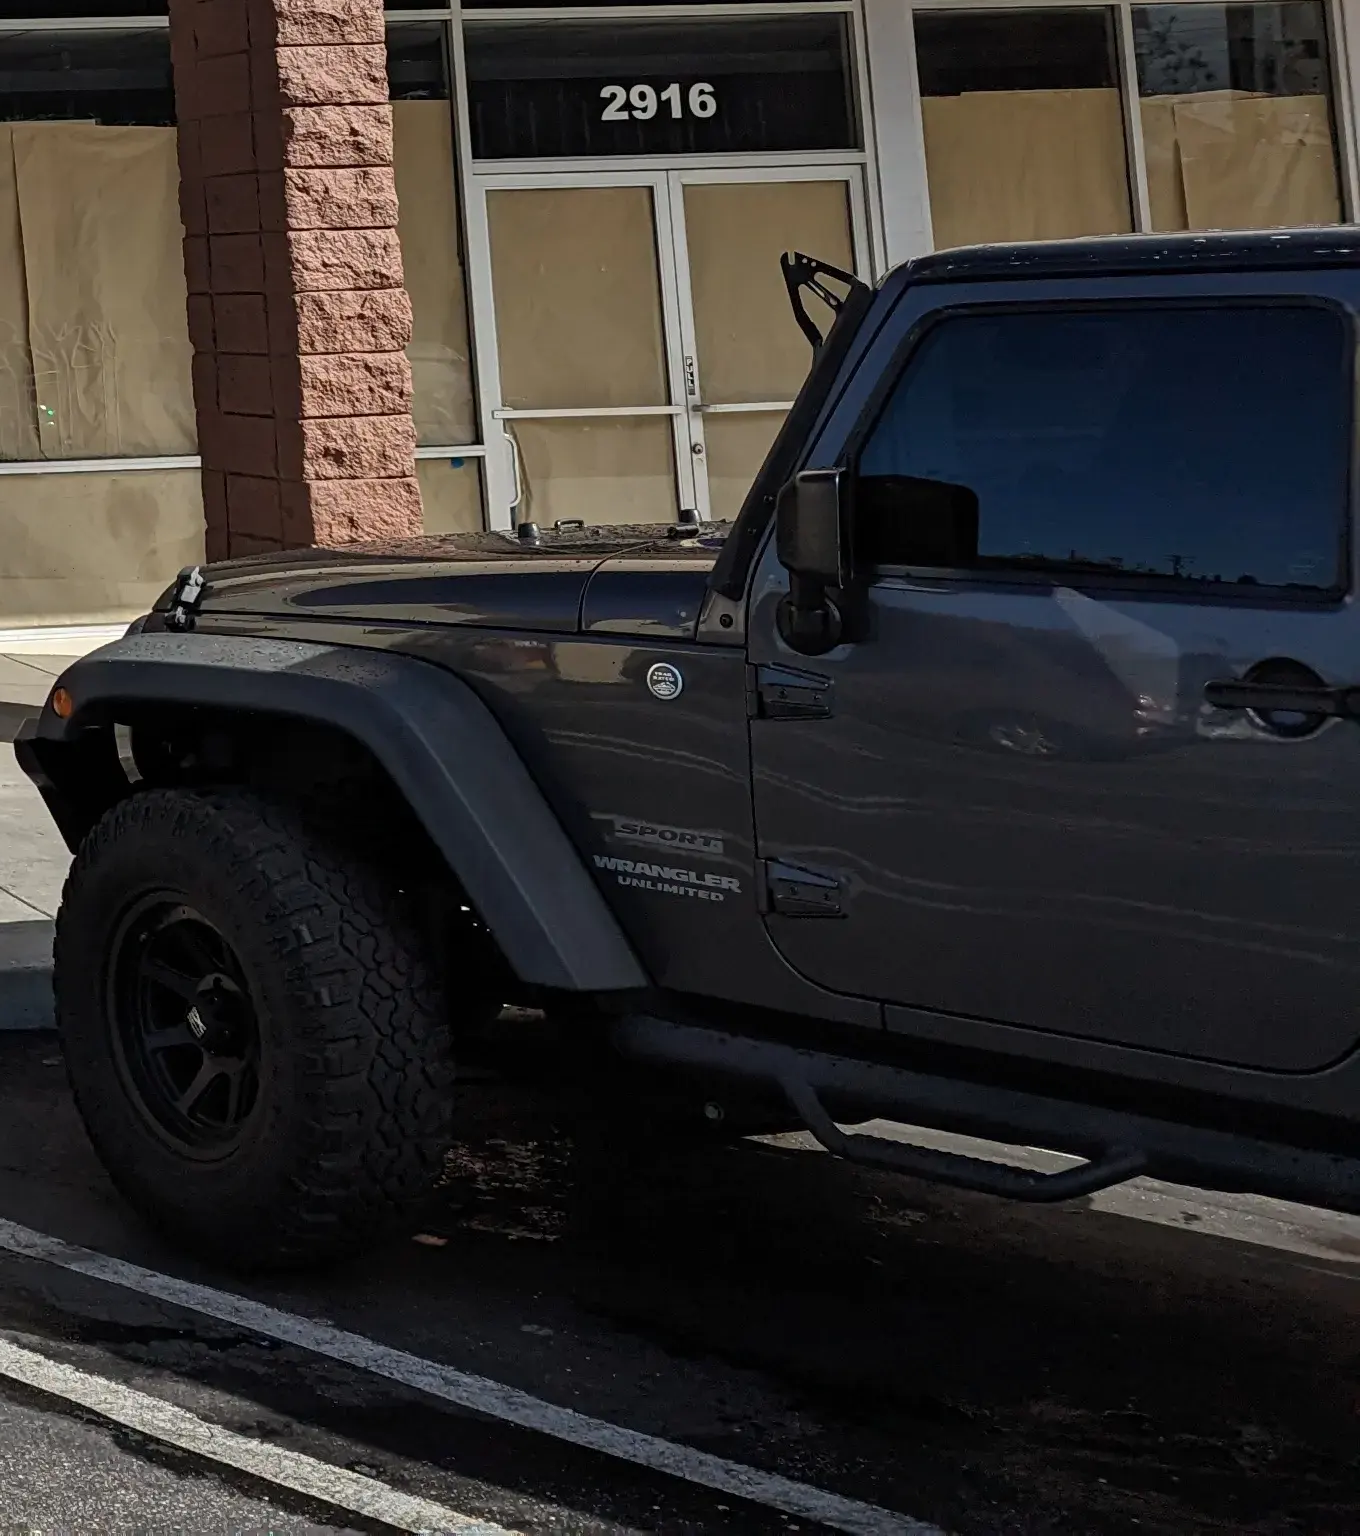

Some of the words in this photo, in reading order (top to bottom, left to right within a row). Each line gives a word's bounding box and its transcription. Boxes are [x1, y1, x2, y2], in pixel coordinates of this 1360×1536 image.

[600, 82, 717, 121] 2916
[686, 358, 694, 386] PULL
[616, 822, 723, 848] SPORT
[593, 855, 742, 893] WRANGLER
[618, 876, 724, 901] UNLIMITED
